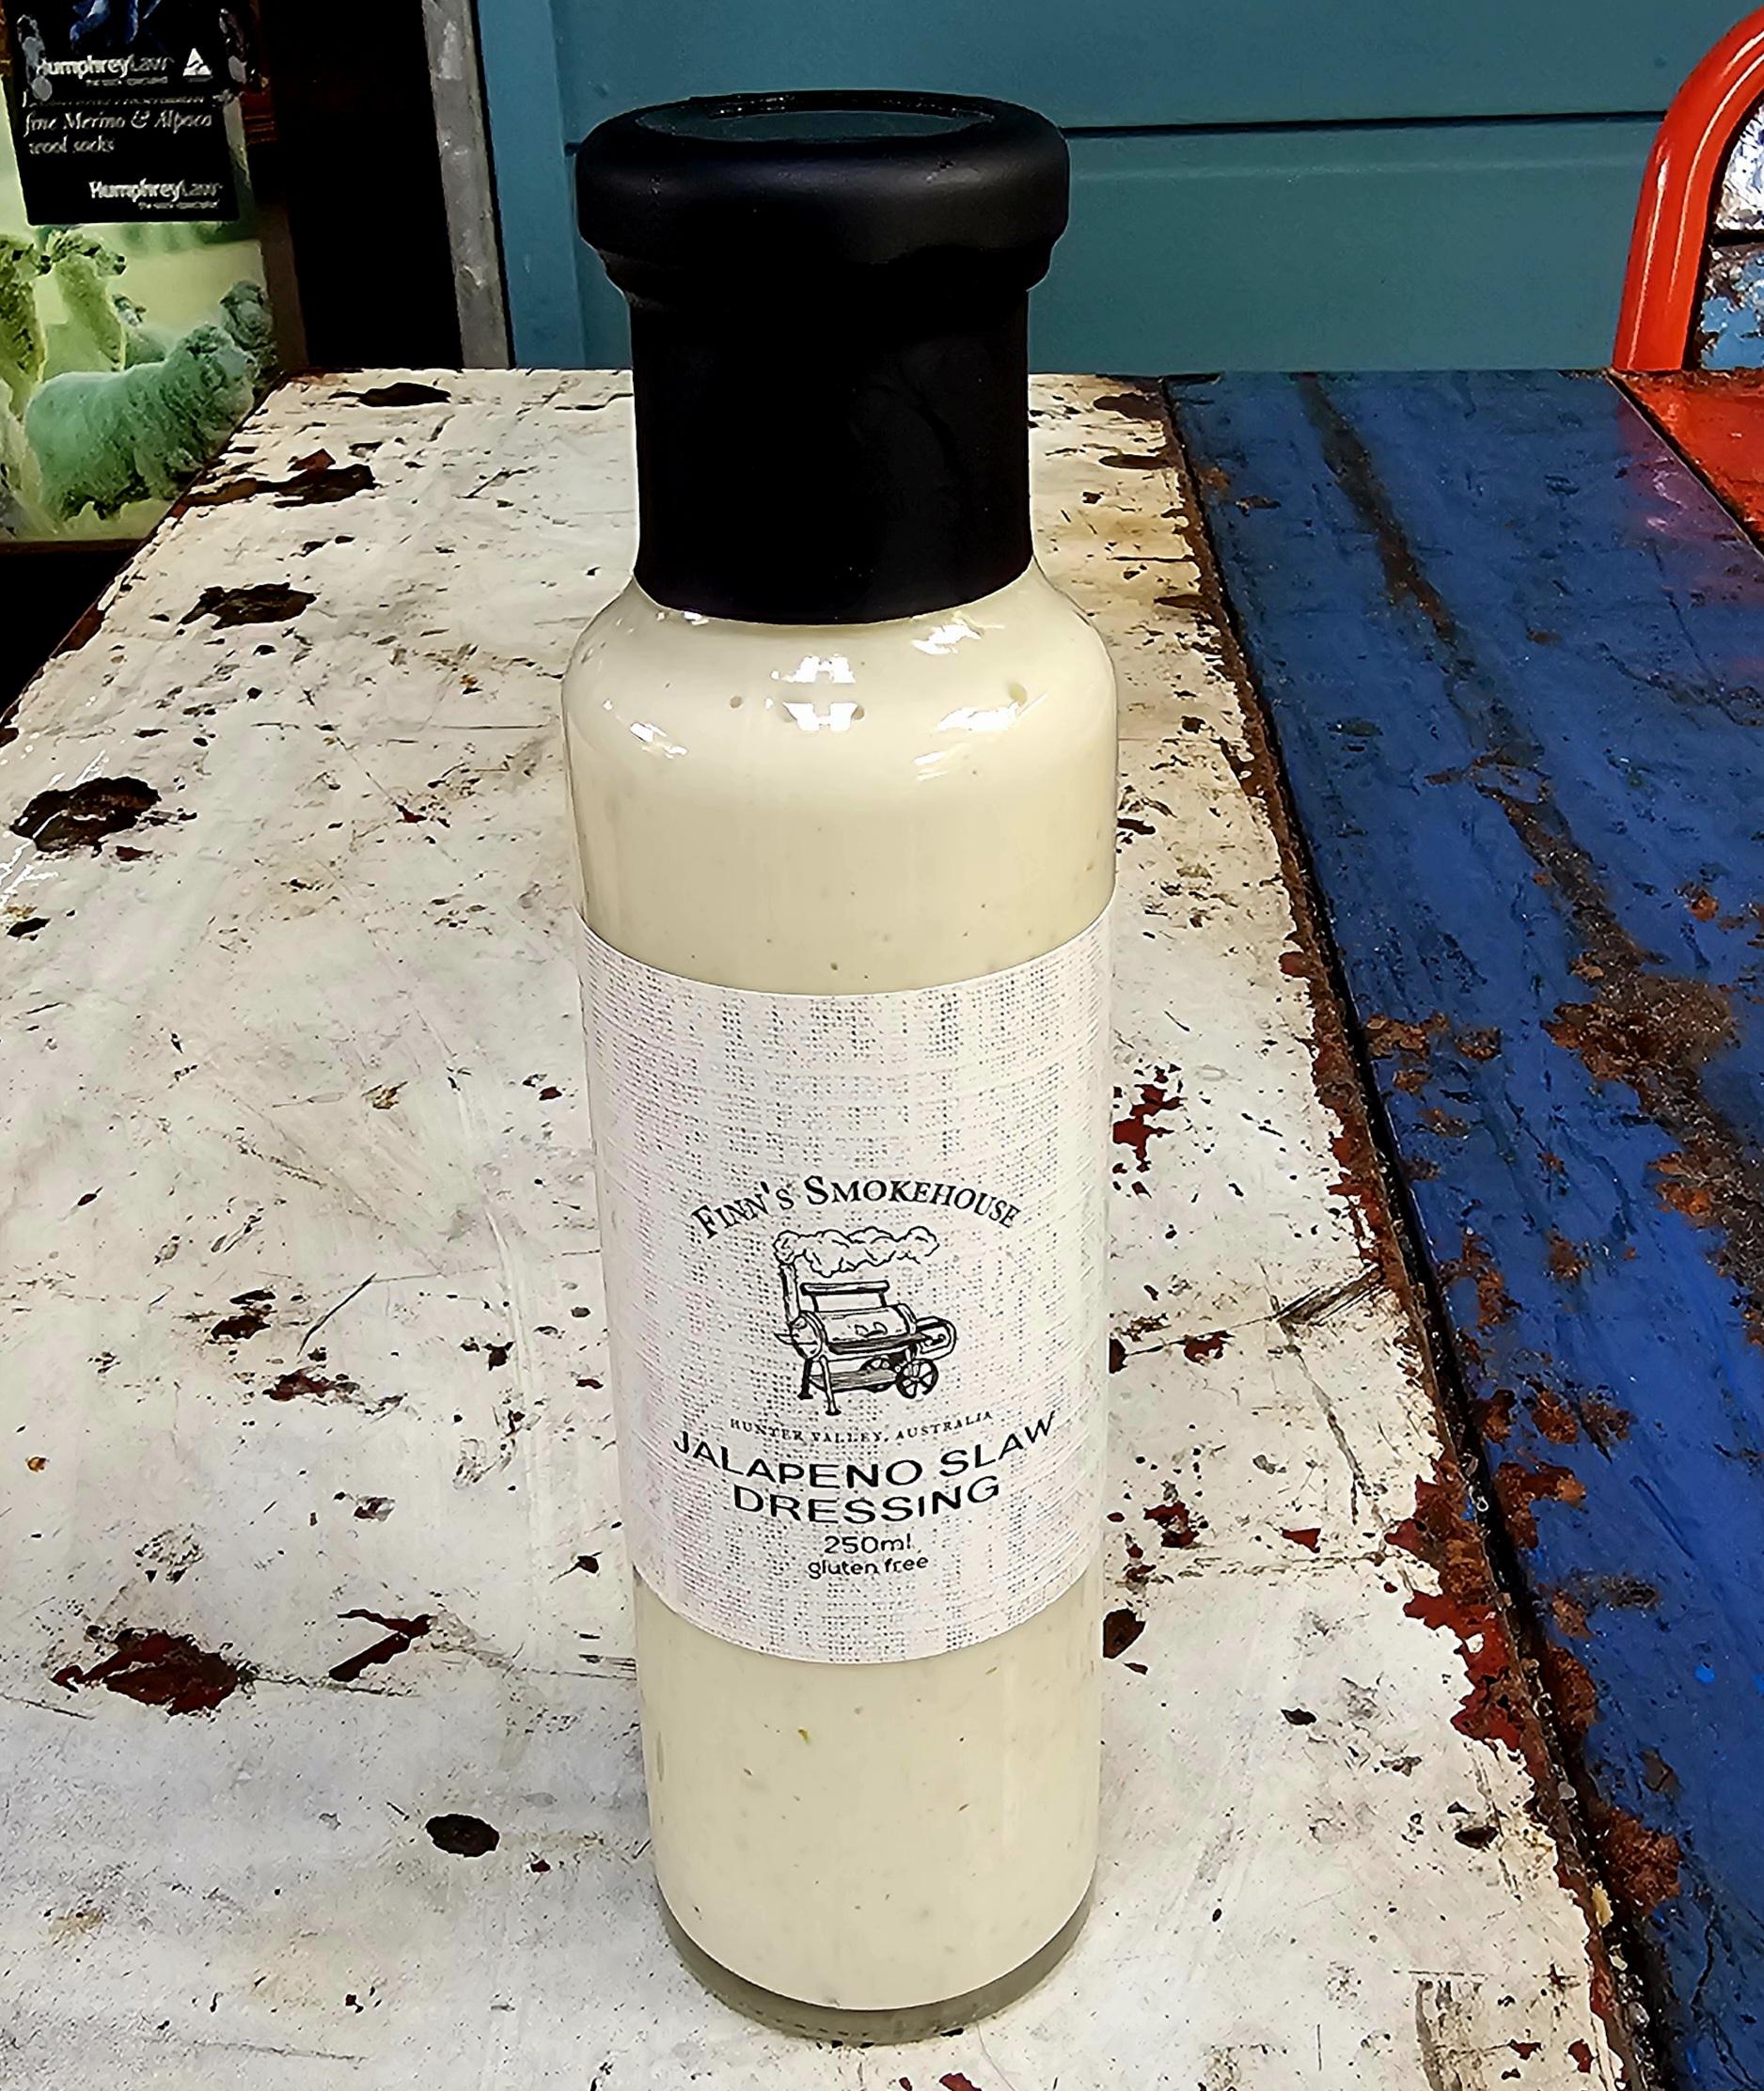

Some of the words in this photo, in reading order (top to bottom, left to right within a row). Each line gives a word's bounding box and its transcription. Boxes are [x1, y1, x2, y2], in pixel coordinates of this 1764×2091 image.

[63, 111, 125, 130] Merino
[131, 110, 150, 129] &
[153, 109, 213, 134] Alpaca
[691, 1181, 795, 1239] FINN'S
[804, 1175, 1022, 1229] SMOKEHOUSE
[730, 1418, 804, 1442] HUNTER
[895, 1411, 993, 1440] AUSTRALIA
[673, 1430, 923, 1489] JALAPENO
[939, 1410, 1056, 1477] SLAW
[733, 1475, 1000, 1524] DRESSING
[824, 1533, 912, 1553] 250ml
[808, 1557, 877, 1580] gluten
[884, 1555, 929, 1573] free
